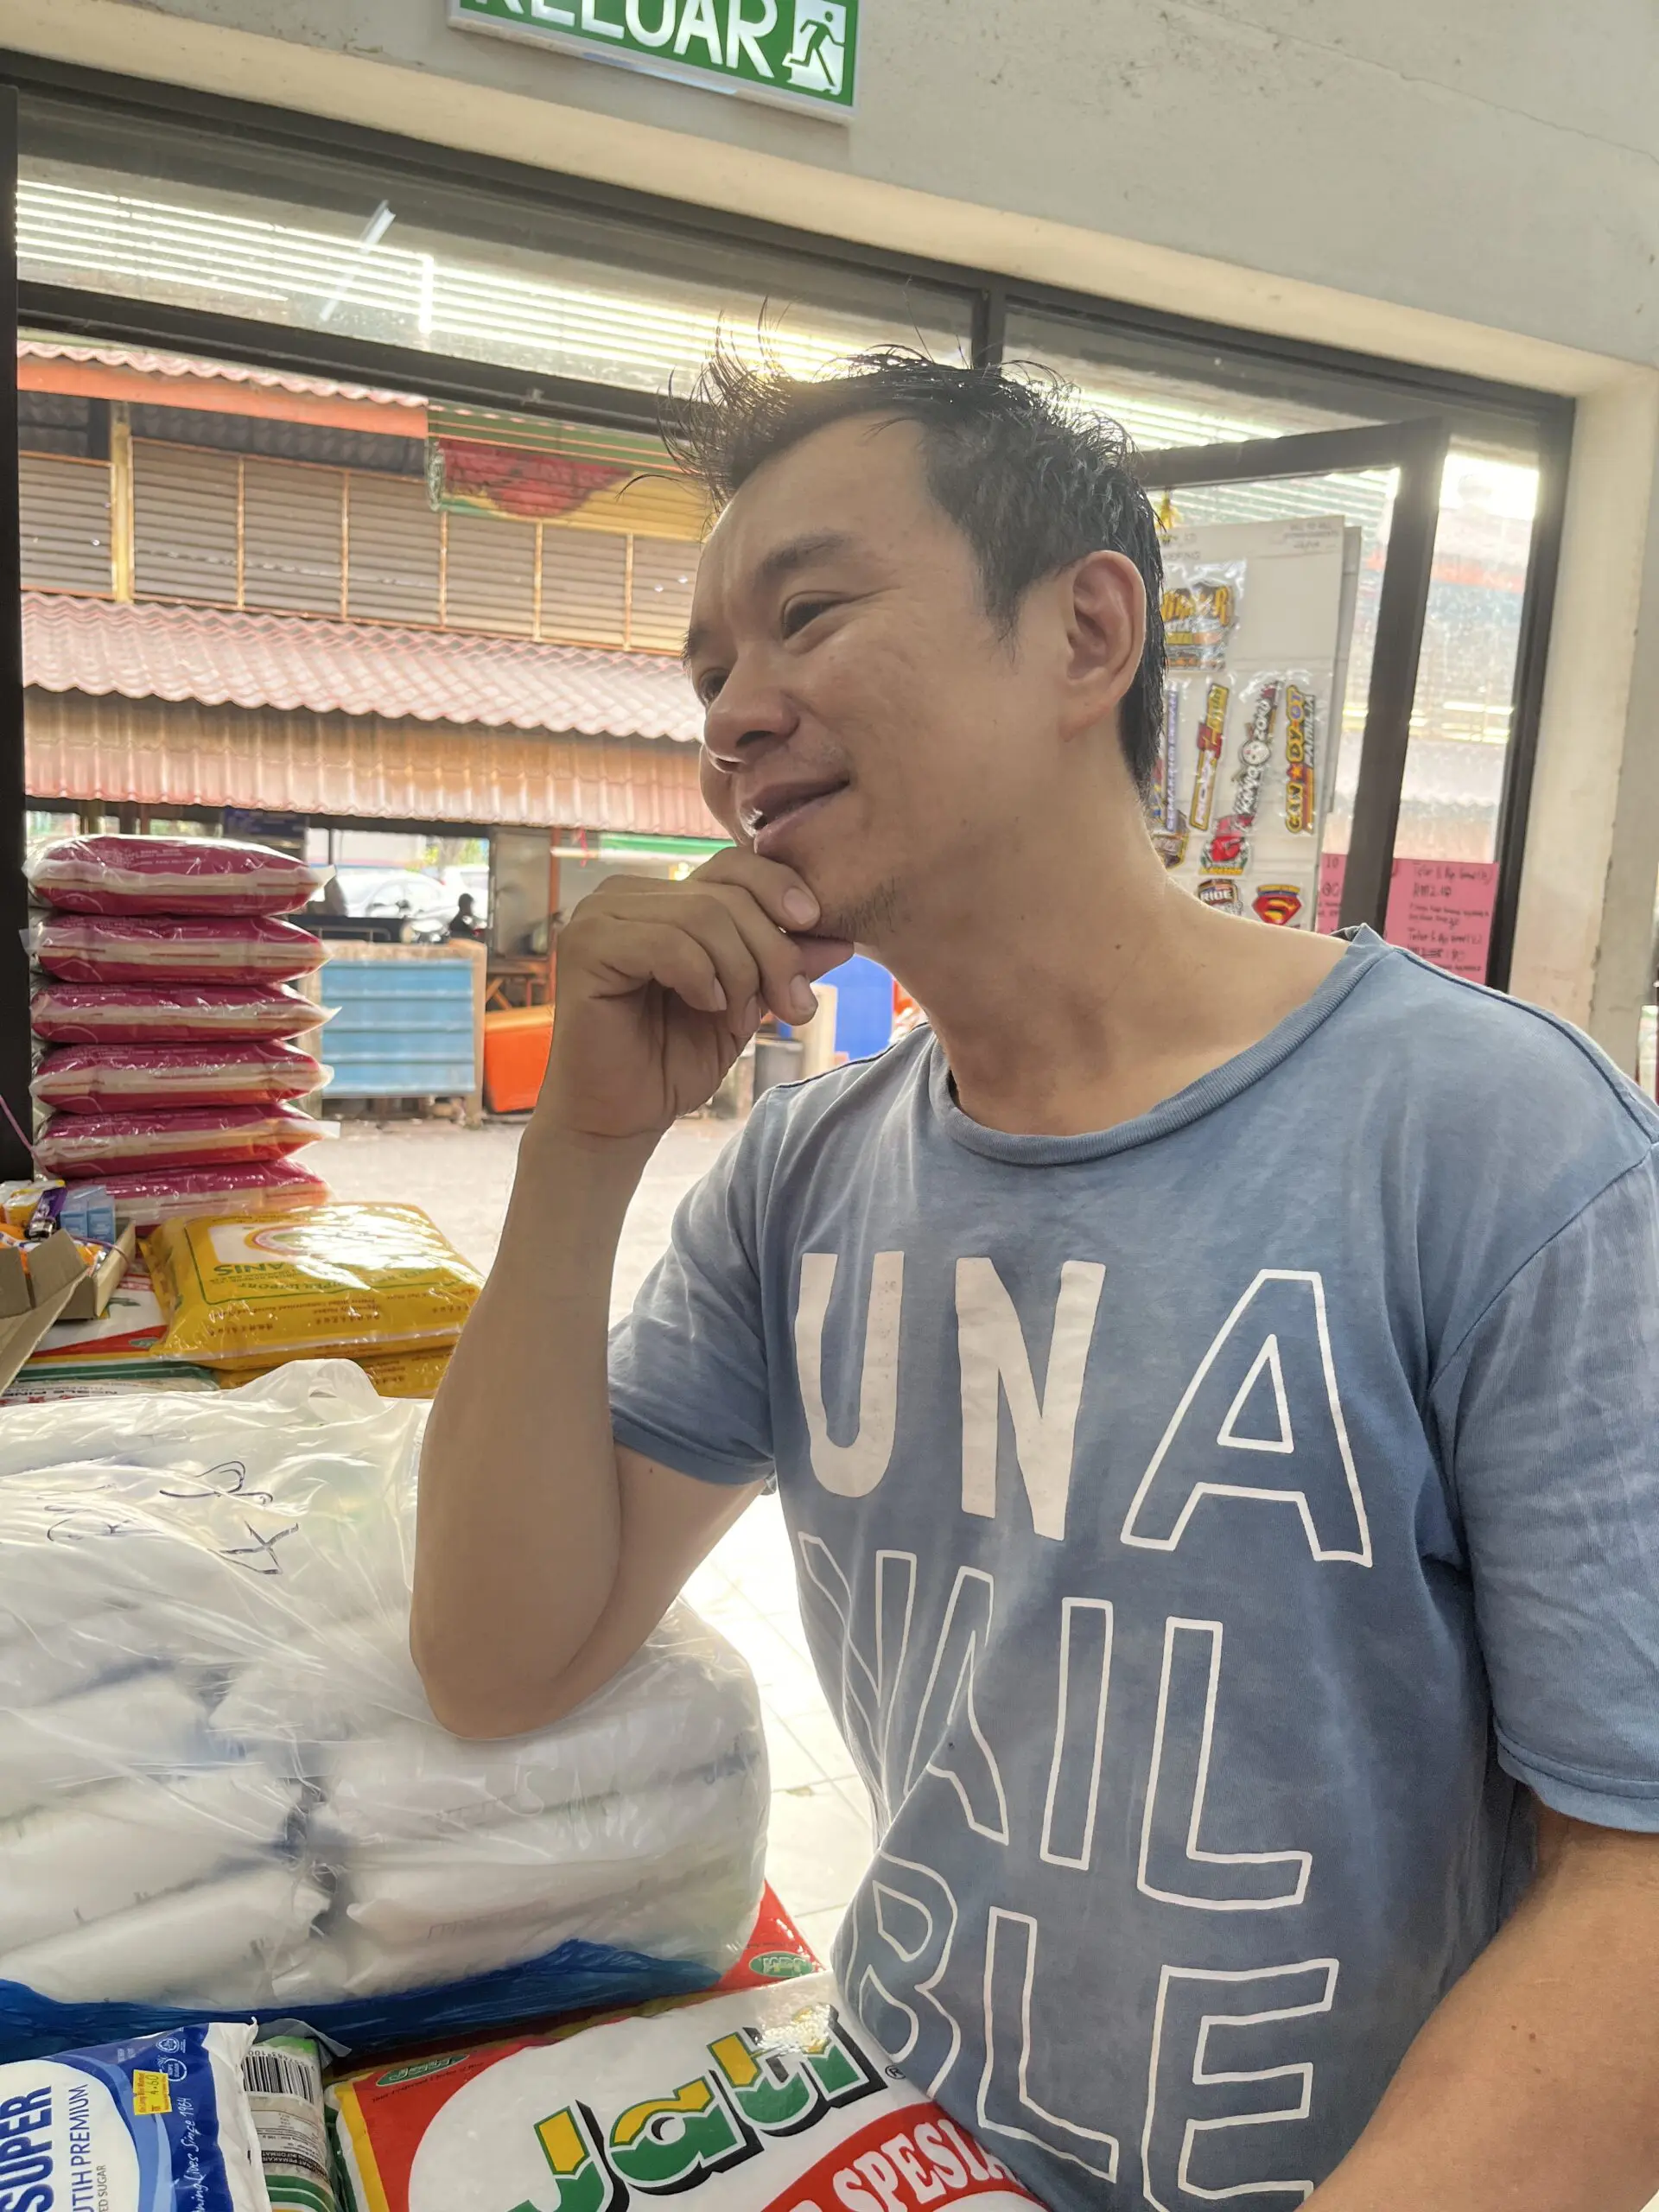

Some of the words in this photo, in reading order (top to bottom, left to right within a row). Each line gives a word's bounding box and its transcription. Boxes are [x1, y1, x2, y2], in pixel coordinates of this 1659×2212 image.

[472, 0, 774, 79] LUAR
[793, 1249, 1375, 1568] UNA
[798, 1530, 1313, 1909] VAIL
[835, 1852, 1341, 2212] BLE
[68, 2083, 92, 2166] PREMIUM
[144, 2075, 160, 2095] 4.60
[175, 2096, 194, 2117] 1964
[506, 2001, 888, 2212] Jati
[0, 2085, 54, 2212] SUPER
[180, 2119, 200, 2152] Since
[183, 2152, 207, 2183] Lives
[95, 2164, 108, 2197] SUGAR
